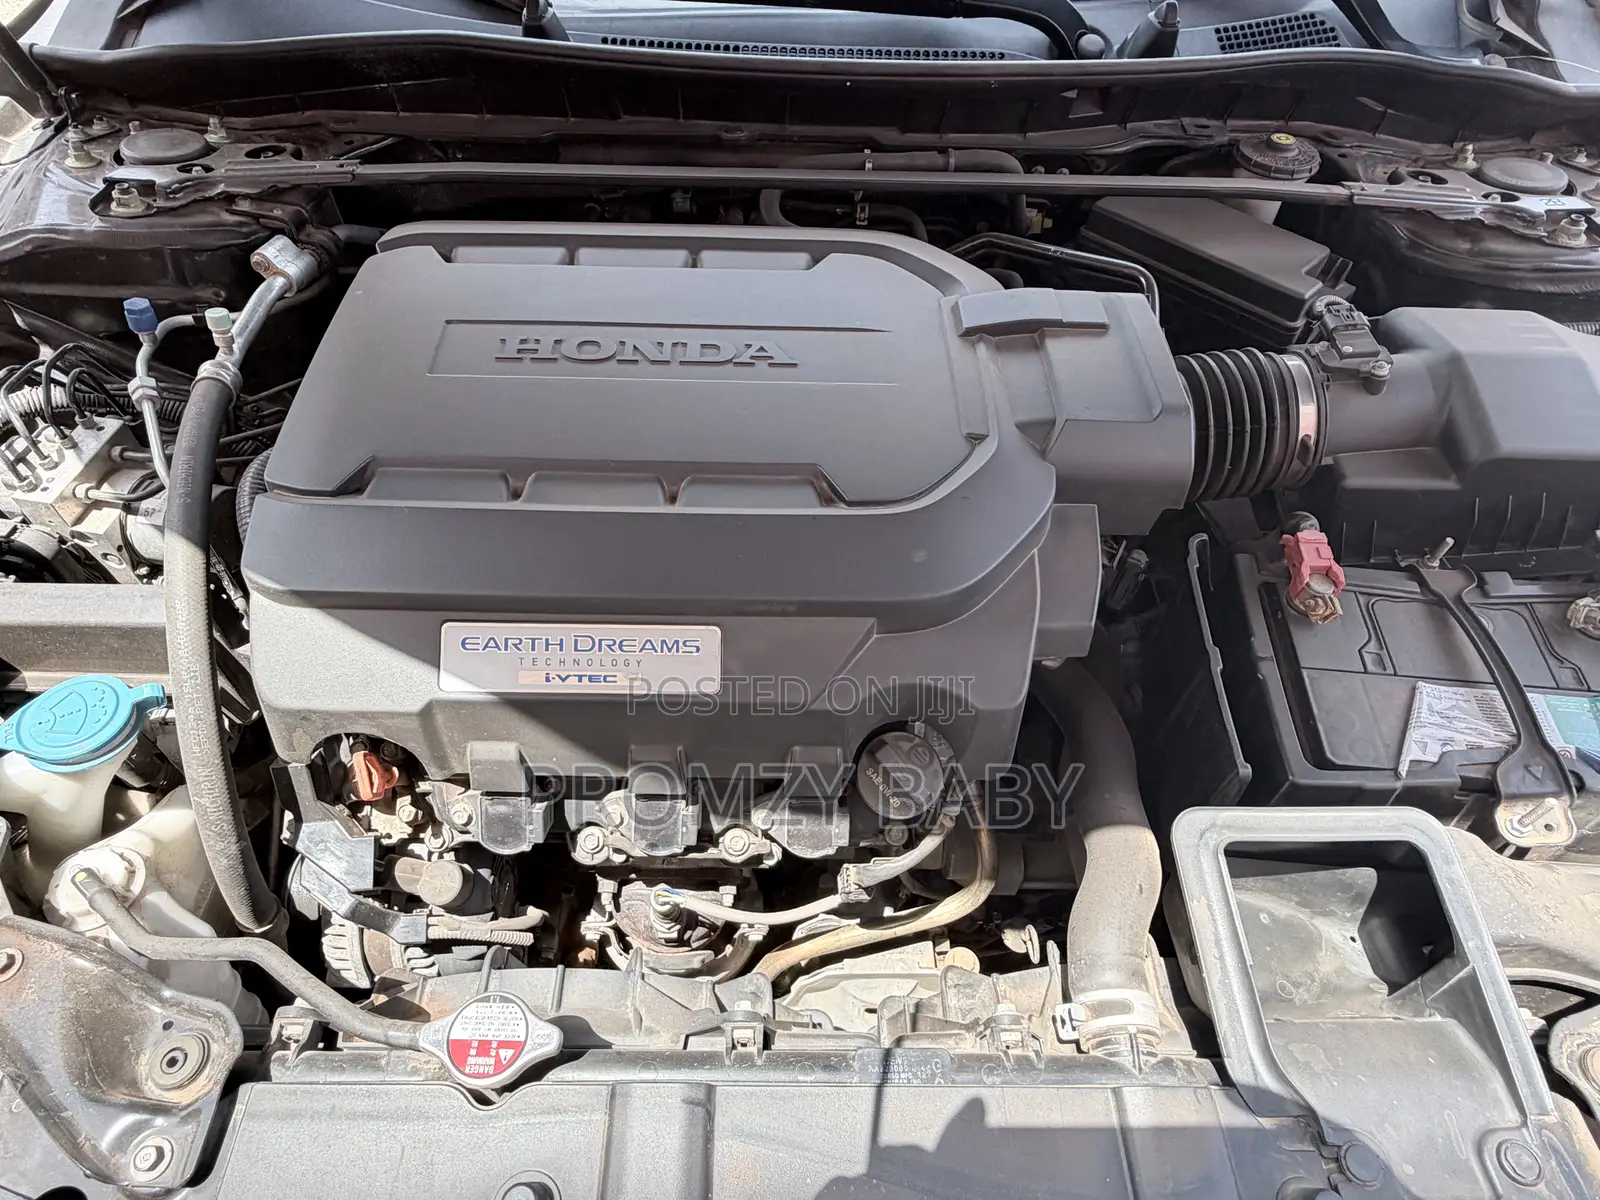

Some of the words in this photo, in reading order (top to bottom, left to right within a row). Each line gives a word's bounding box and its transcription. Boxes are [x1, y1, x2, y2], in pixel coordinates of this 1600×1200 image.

[495, 336, 799, 367] HONDA
[459, 634, 566, 654] EARTH
[572, 632, 702, 656] DREAMS
[518, 656, 643, 668] TECHNOLOGY
[544, 672, 618, 684] i-VTEC
[866, 767, 882, 785] SAE
[879, 782, 901, 808] 0W-20
[464, 1064, 495, 1074] DANGER
